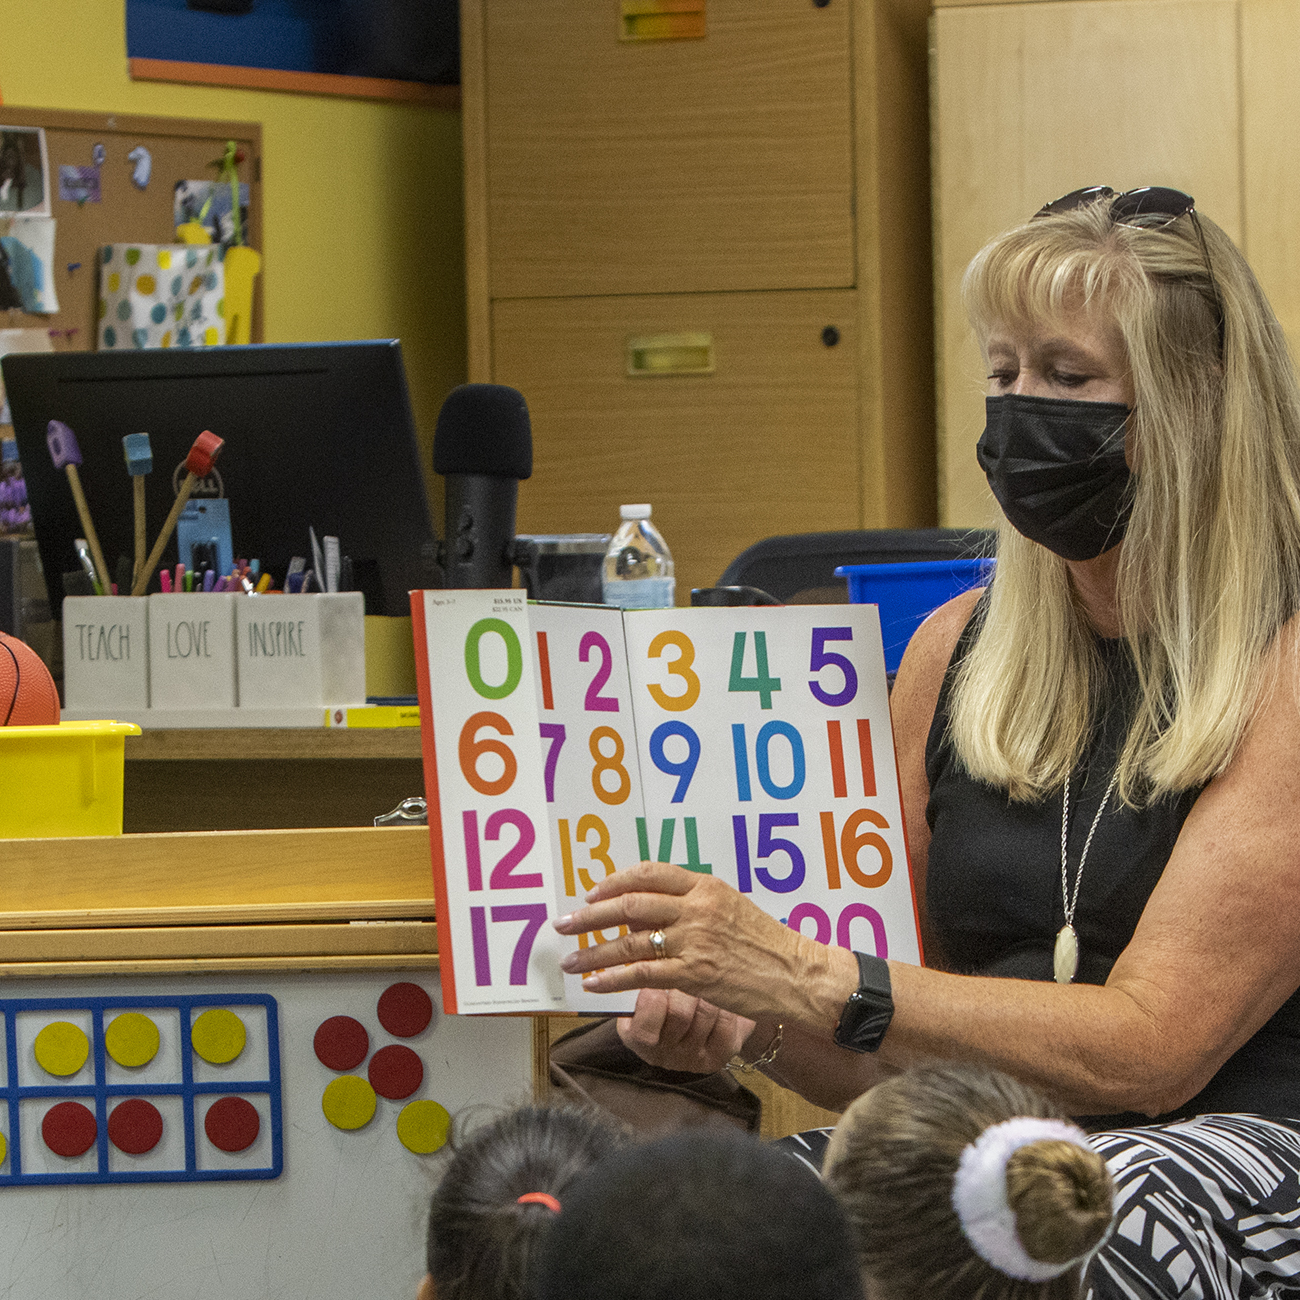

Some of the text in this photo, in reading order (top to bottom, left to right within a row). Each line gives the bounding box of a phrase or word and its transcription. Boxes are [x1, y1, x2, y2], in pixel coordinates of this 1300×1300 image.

[75, 624, 131, 661] TEACH
[167, 620, 211, 659] LOVE
[248, 620, 306, 658] INSPIRE
[464, 617, 859, 712] 0 1 2 3 4 5
[457, 711, 878, 806] 6 7 8 9 10 11
[461, 808, 894, 897] 12 13 14 15 16
[468, 902, 549, 987] 17
